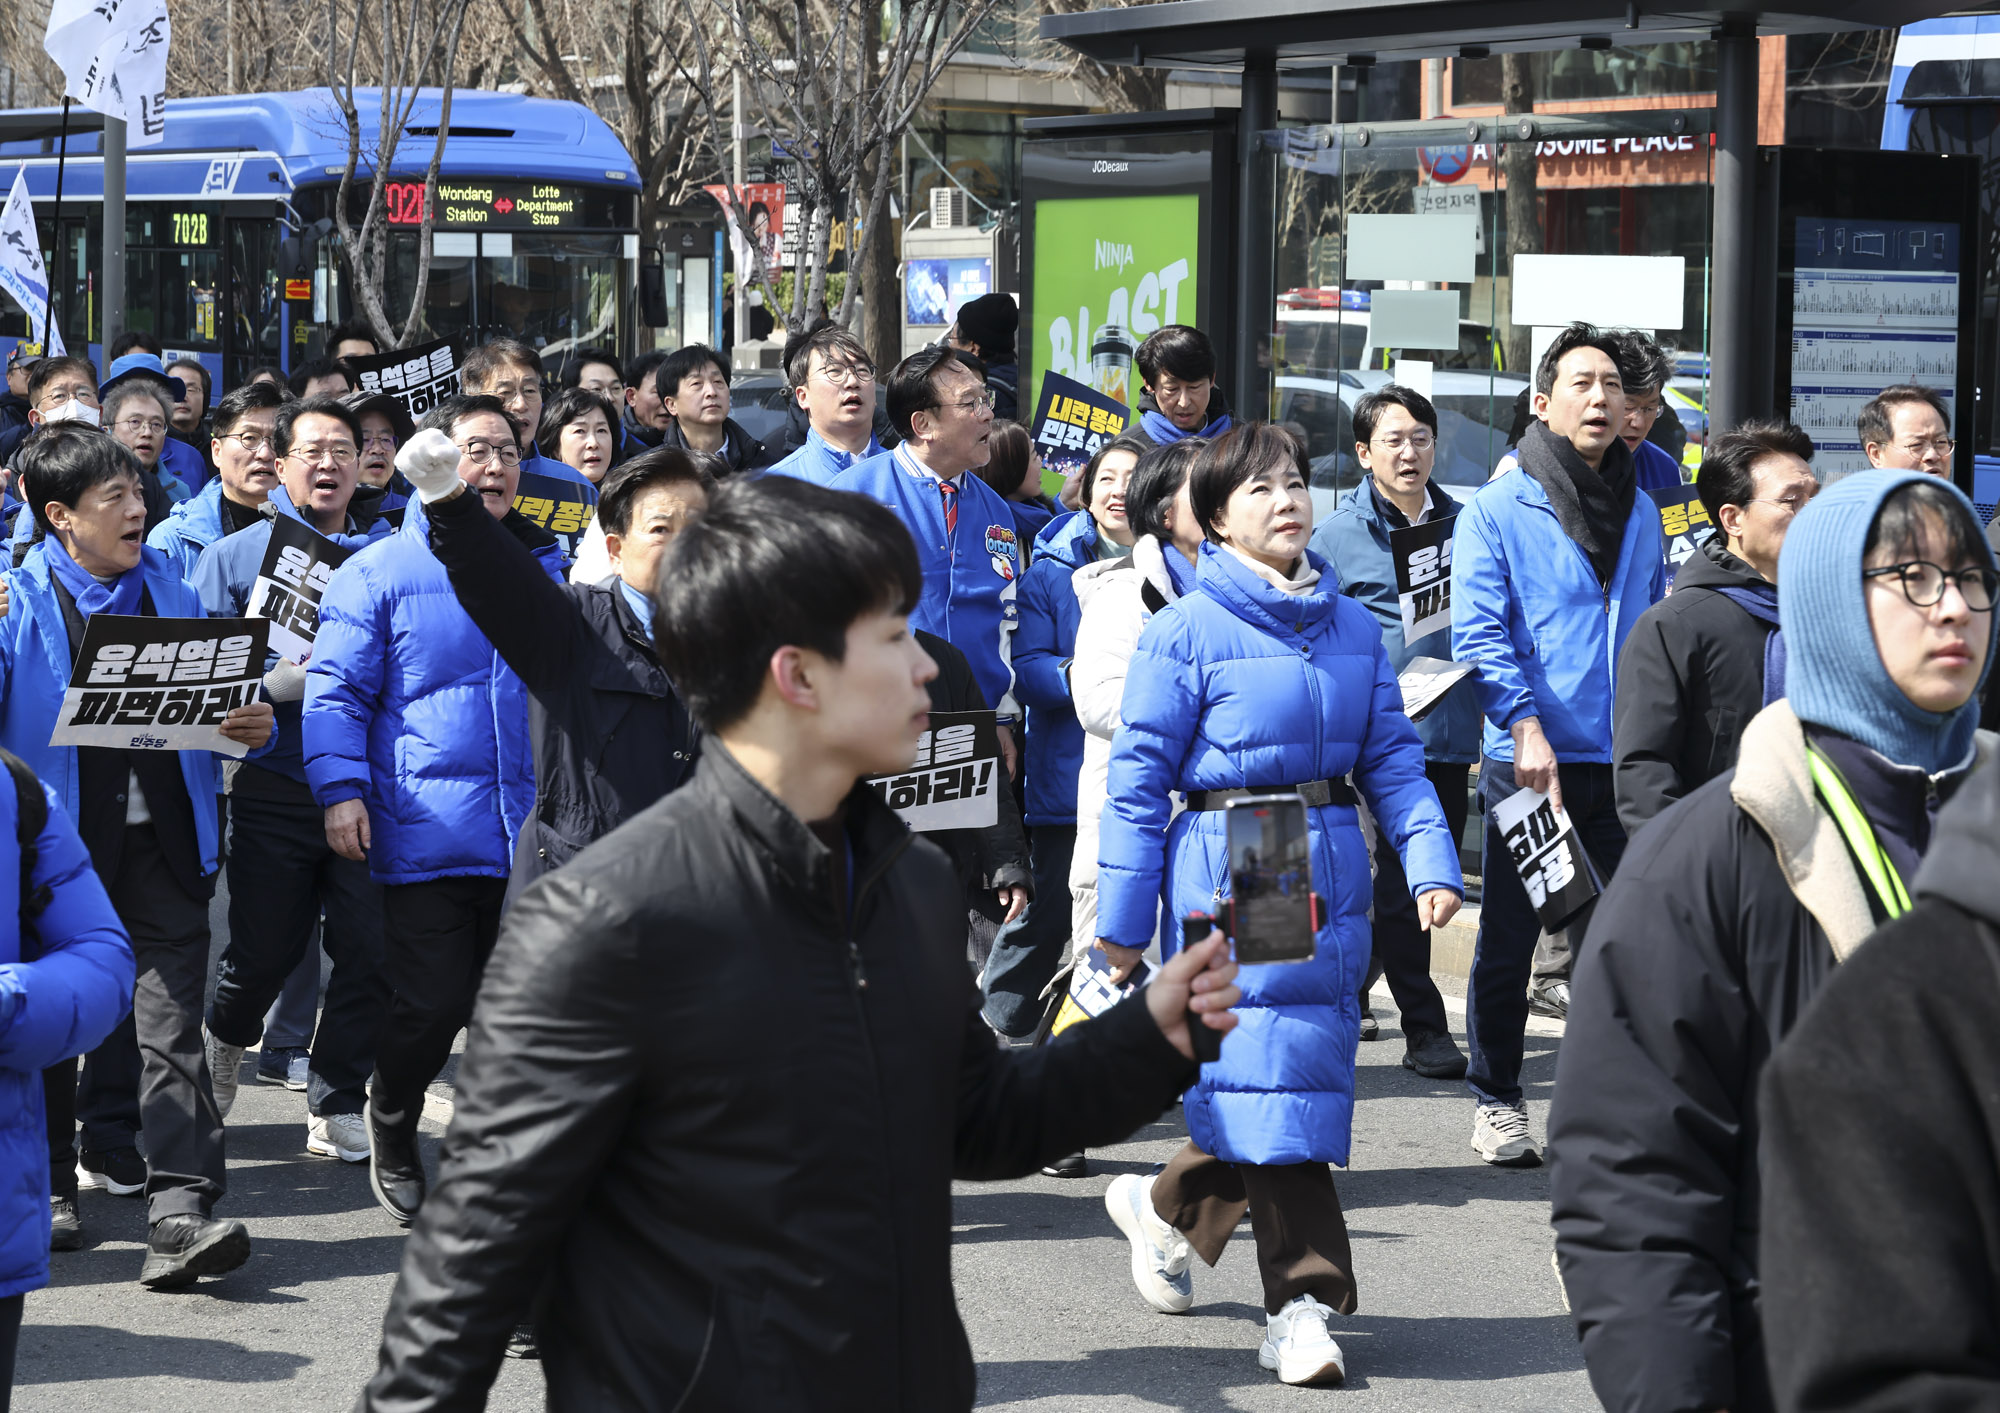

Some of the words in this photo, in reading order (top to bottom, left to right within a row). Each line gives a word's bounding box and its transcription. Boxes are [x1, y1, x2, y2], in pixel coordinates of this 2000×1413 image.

[1473, 144, 1488, 160] A
[1614, 136, 1693, 154] PLACE
[208, 162, 237, 192] EV
[1092, 161, 1129, 174] JCDecaux
[438, 185, 493, 204] Wondang
[532, 185, 560, 199] Lotte
[516, 199, 573, 213] Department
[1419, 194, 1477, 211] 견인지역
[446, 206, 488, 223] Station
[532, 212, 560, 226] Store
[173, 213, 208, 244] 702B
[1095, 238, 1134, 276] NINJA
[1049, 258, 1189, 389] BLAST
[360, 345, 454, 394] 윤석열을
[86, 635, 253, 684] 윤석열을
[129, 737, 168, 748] 민주당
